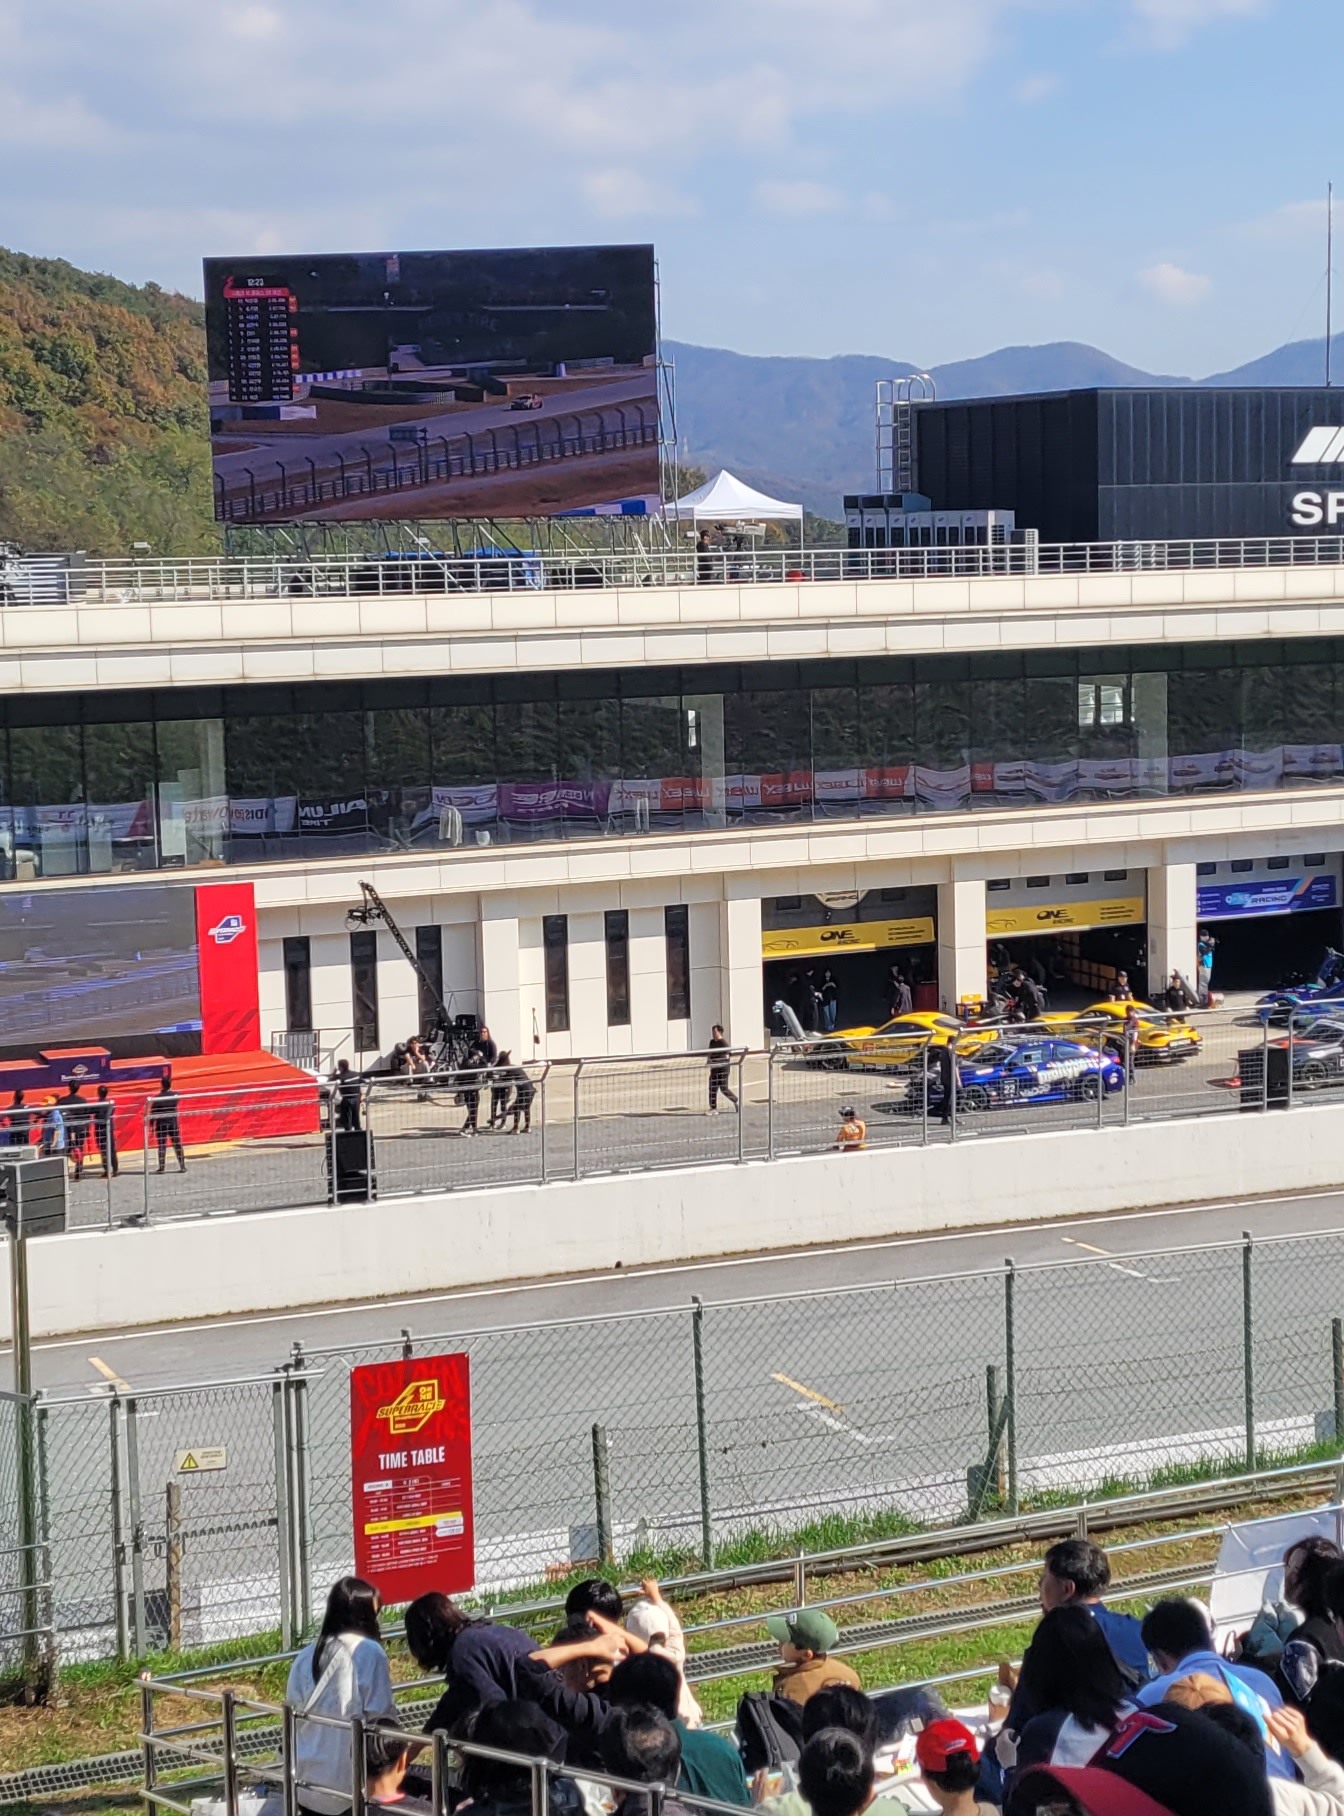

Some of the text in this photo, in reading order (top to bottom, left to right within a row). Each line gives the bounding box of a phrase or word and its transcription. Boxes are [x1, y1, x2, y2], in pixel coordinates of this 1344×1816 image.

[1036, 908, 1069, 920] ONE
[820, 929, 856, 941] ONE
[377, 1445, 446, 1471] TIME TABLE
